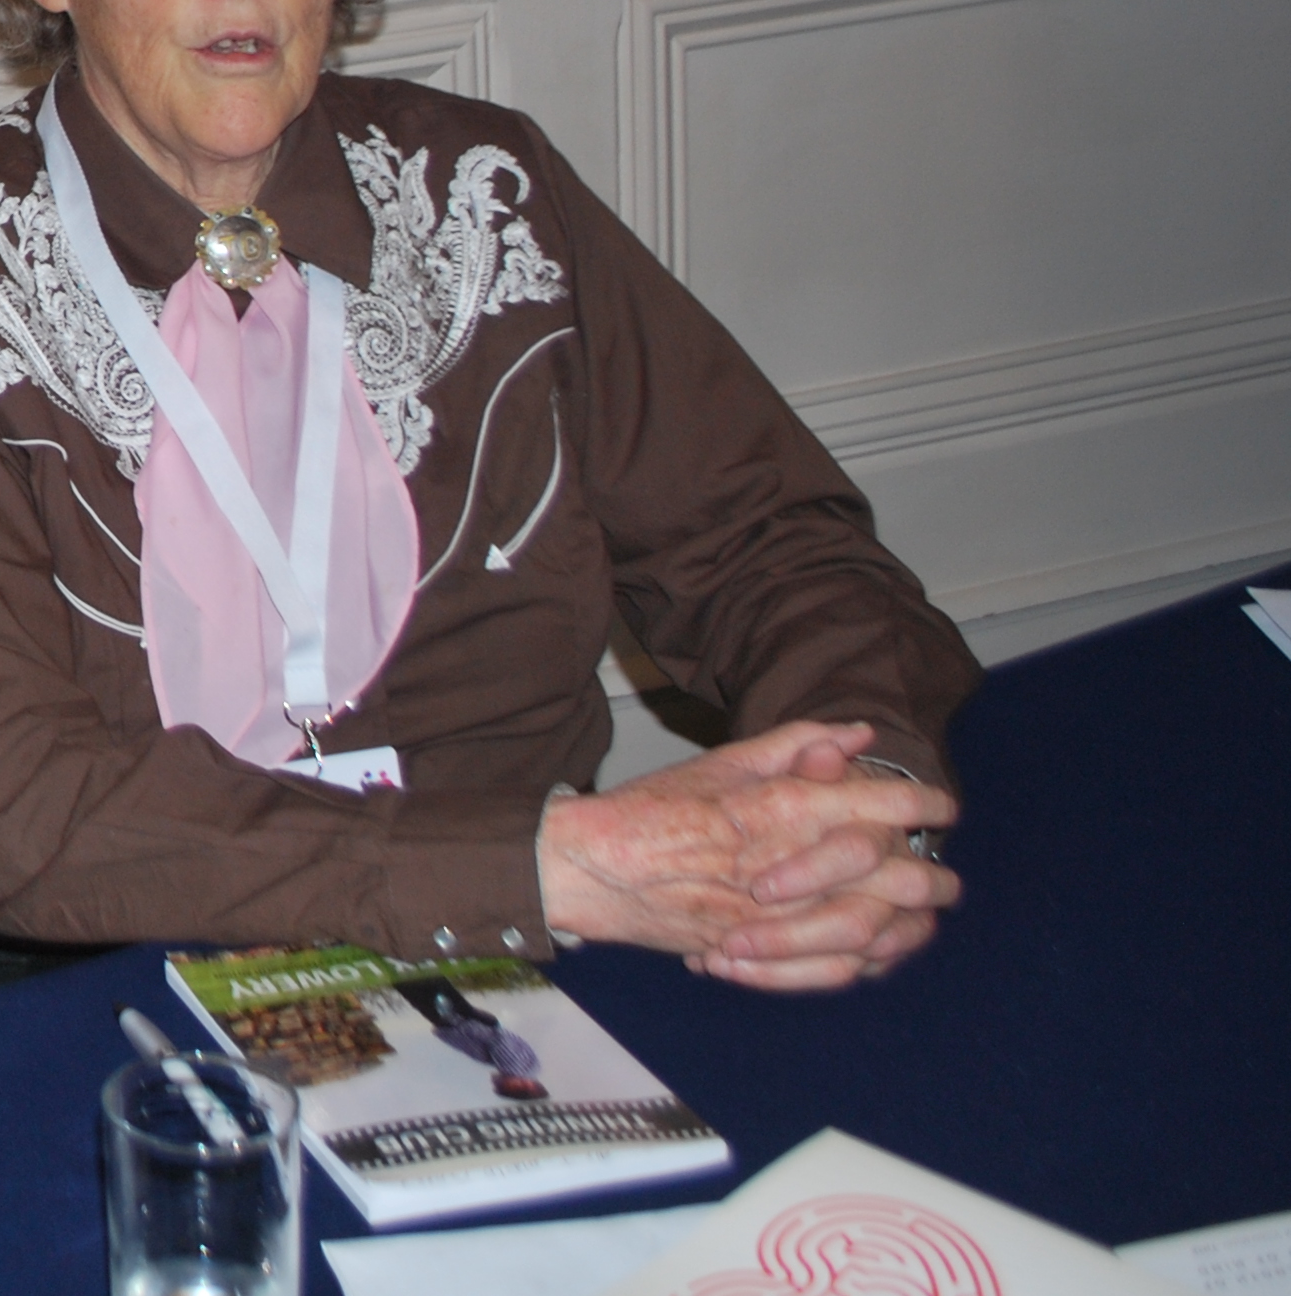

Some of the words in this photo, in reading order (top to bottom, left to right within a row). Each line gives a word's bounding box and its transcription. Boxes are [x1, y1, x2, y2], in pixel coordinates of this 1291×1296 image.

[229, 957, 384, 1001] LOWERY
[373, 1124, 471, 1155] CLUB
[475, 1112, 656, 1141] THINKING
